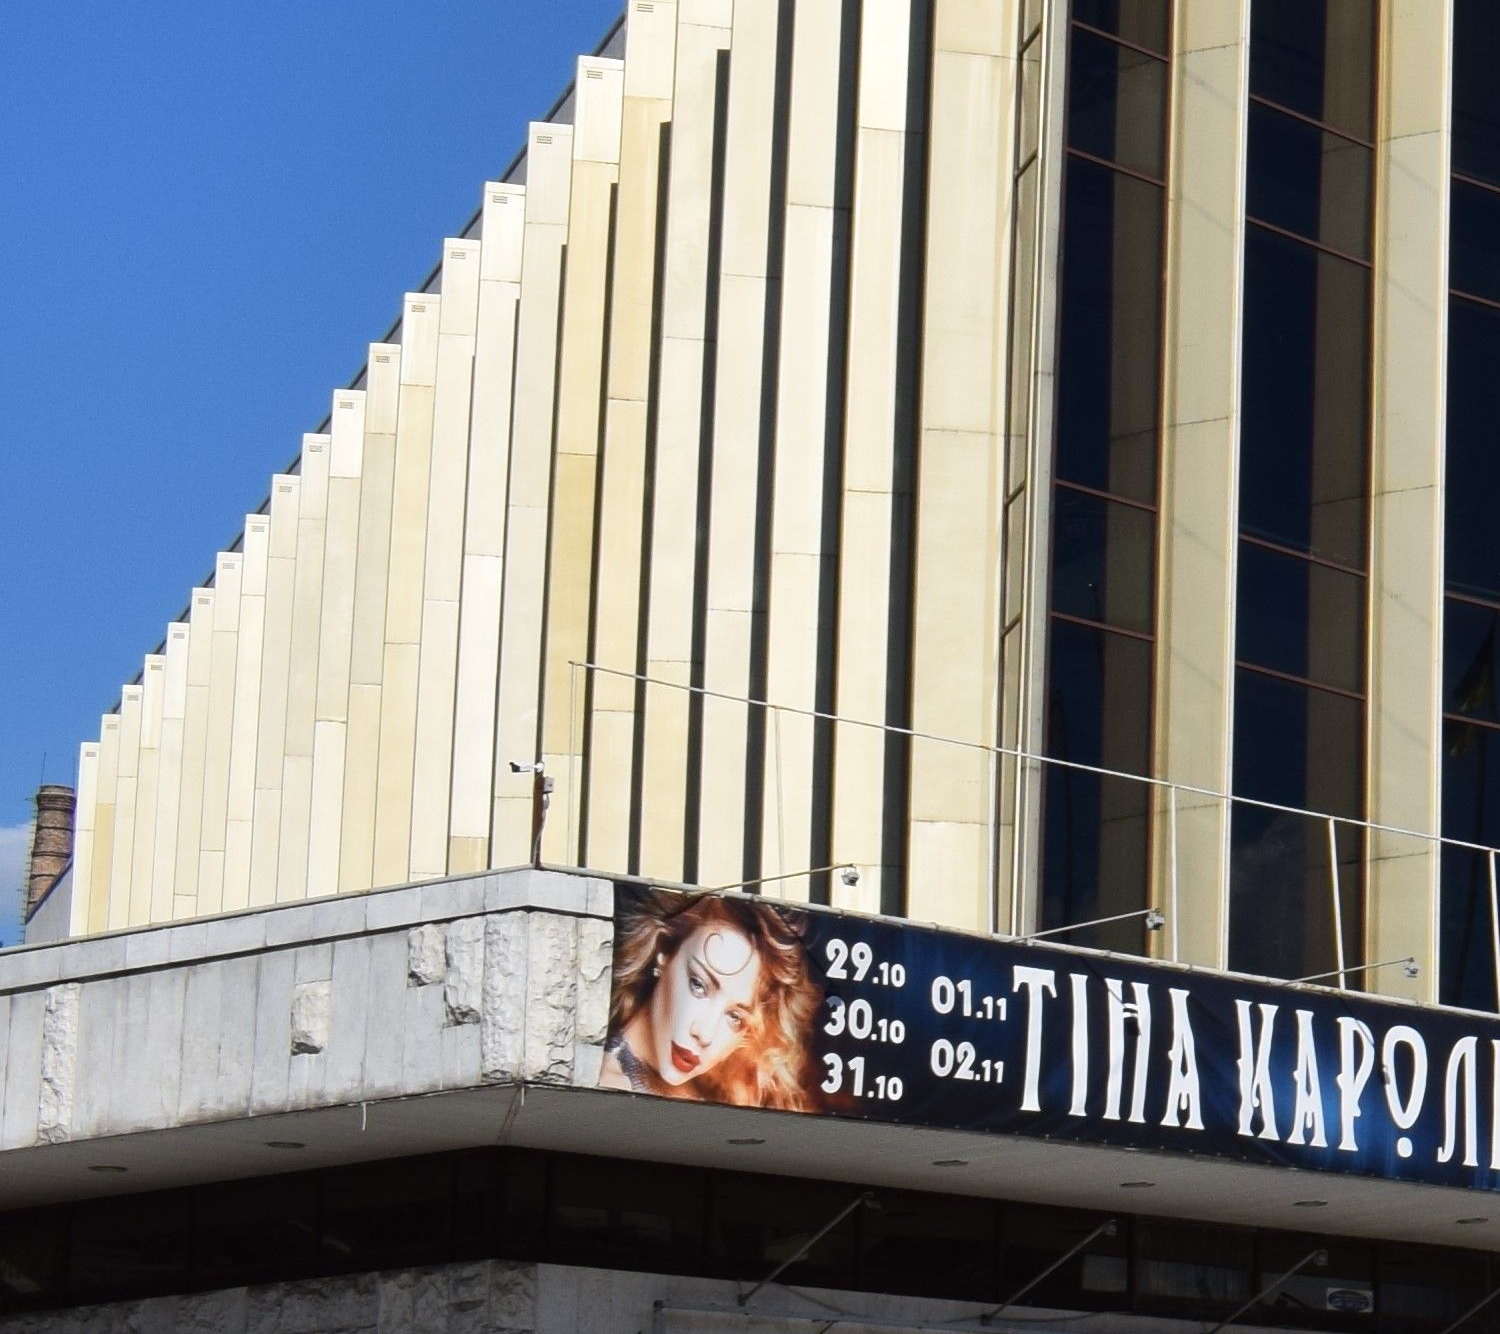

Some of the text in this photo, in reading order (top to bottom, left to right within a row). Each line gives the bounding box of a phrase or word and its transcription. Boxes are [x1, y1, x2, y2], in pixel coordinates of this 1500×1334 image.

[826, 938, 906, 988] 29.10
[824, 995, 906, 1044] 30.10
[931, 975, 1007, 1021] 01.11
[930, 1038, 1004, 1083] 02.11
[1013, 965, 1205, 1130] ТІНА
[820, 1052, 904, 1101] 31.10
